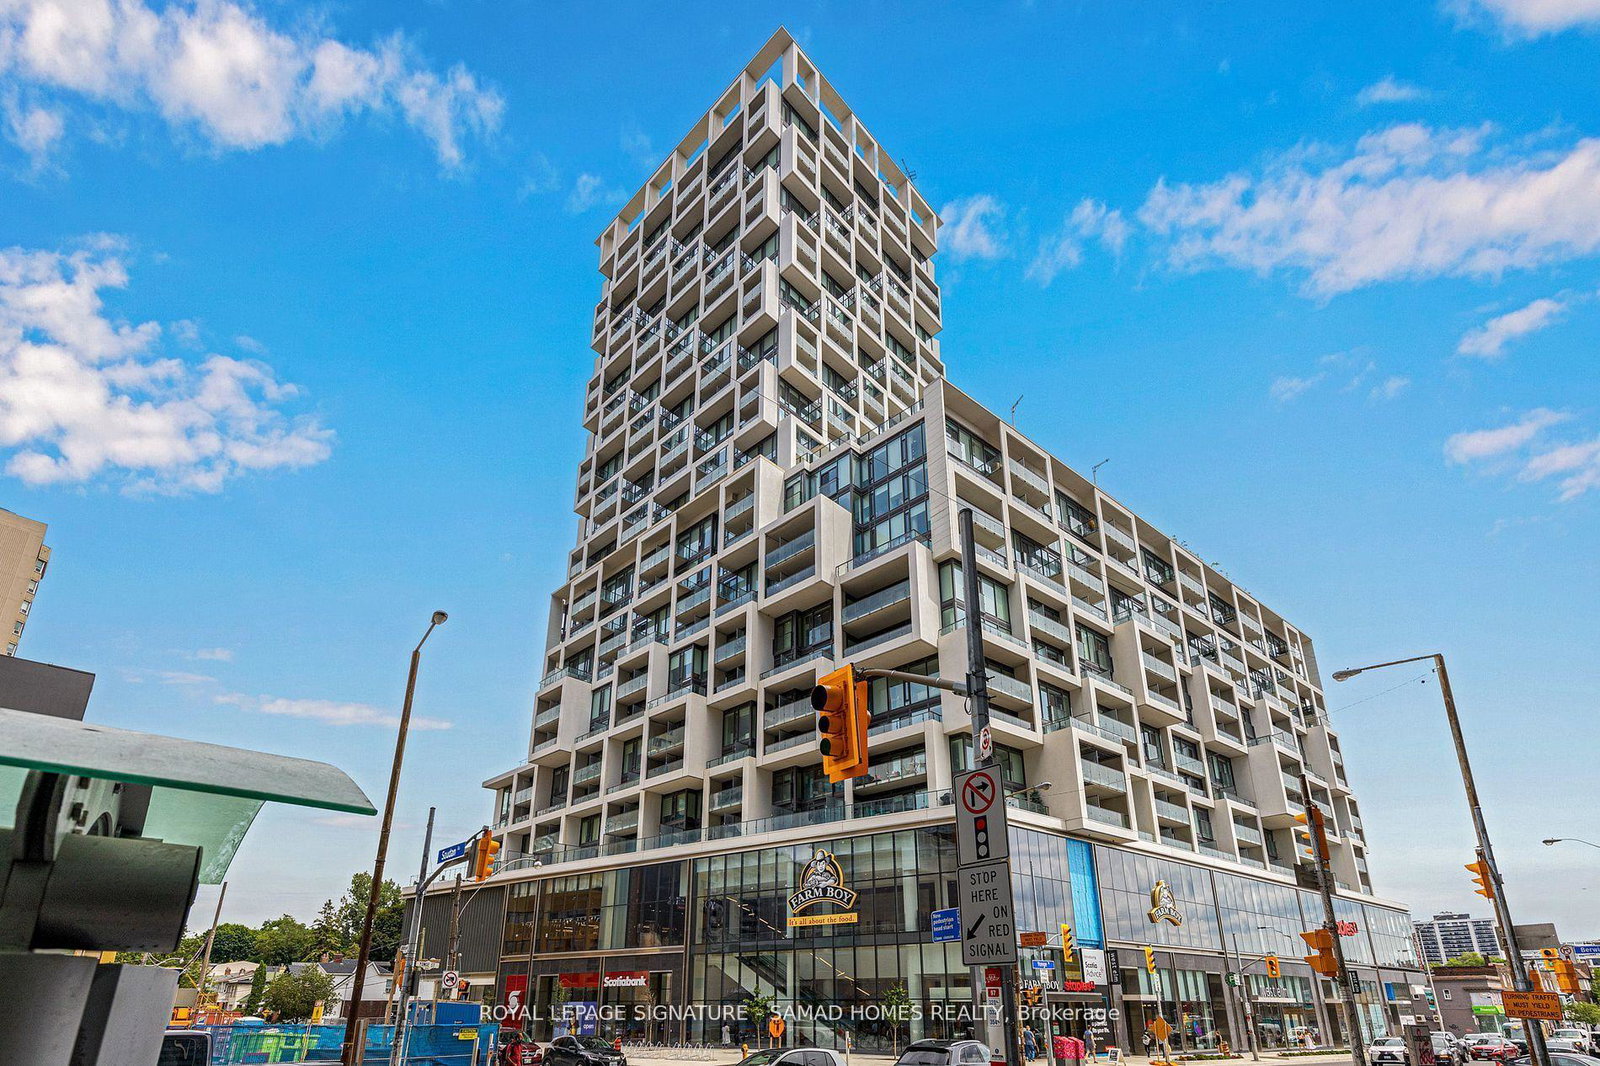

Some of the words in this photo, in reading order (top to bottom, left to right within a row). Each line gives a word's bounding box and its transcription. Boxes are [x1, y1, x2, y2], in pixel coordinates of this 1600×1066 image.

[970, 870, 997, 886] STOP
[790, 887, 823, 909] FARM
[826, 887, 852, 903] BOY
[971, 888, 999, 903] HERE
[993, 905, 1008, 919] ON
[809, 917, 825, 925] about
[989, 924, 1010, 937] RED
[969, 943, 1009, 957] SIGNAL
[603, 975, 647, 987] Scotiabank
